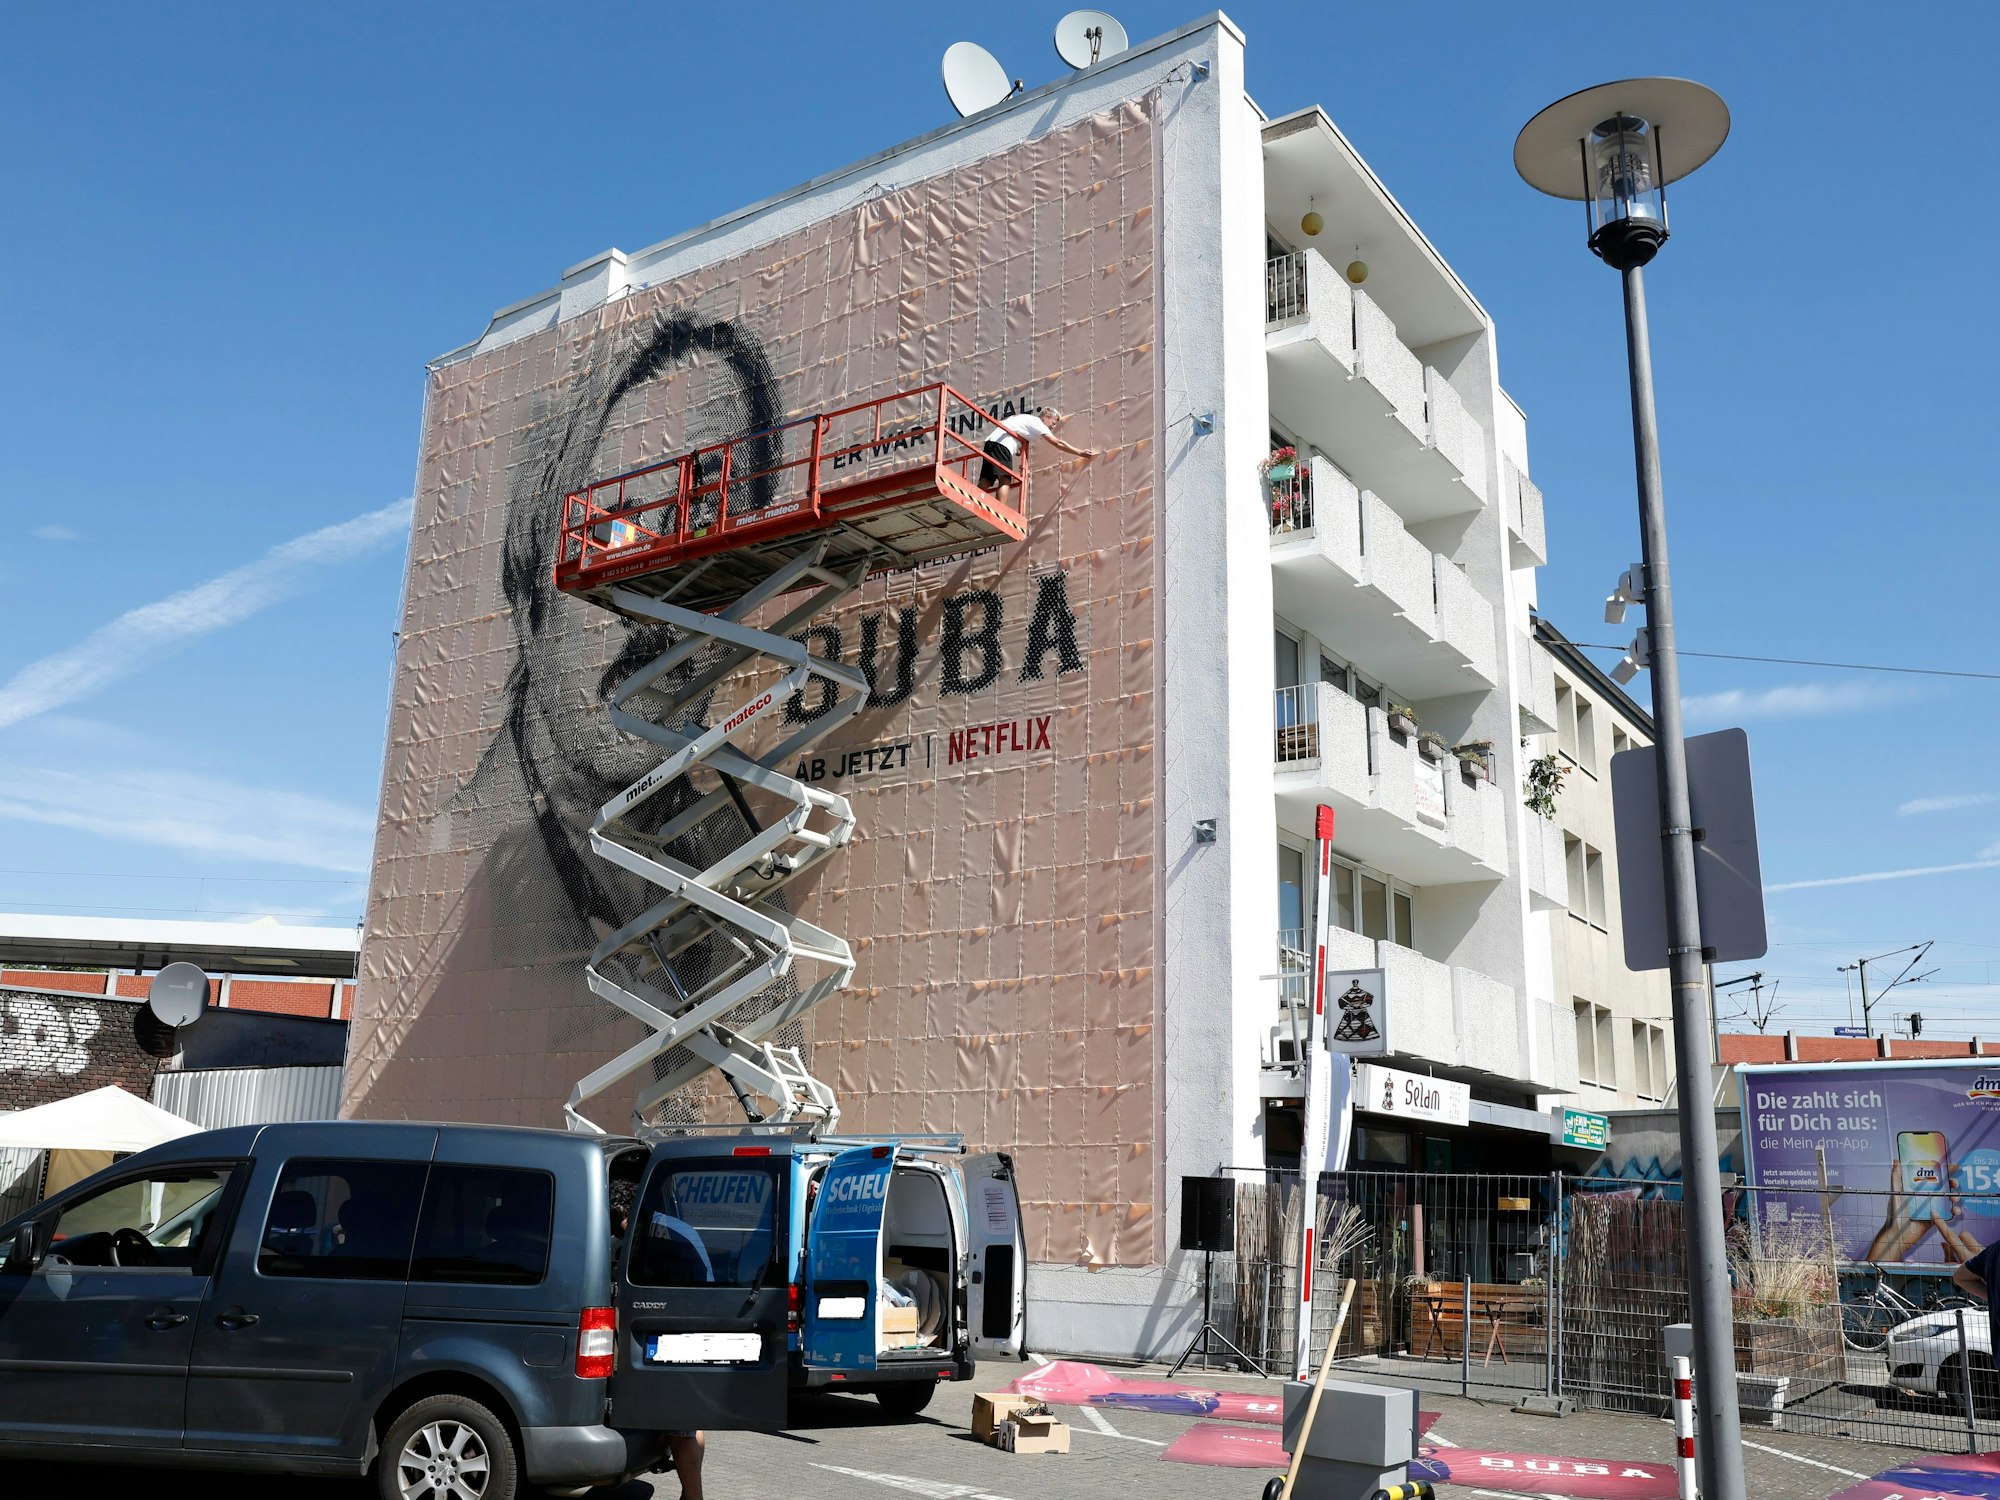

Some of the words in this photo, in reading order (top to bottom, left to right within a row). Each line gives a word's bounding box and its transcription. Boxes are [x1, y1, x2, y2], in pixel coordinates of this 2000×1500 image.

[833, 443, 862, 469] ER
[871, 426, 925, 458] WAR
[764, 502, 800, 519] mateco
[606, 543, 652, 561] www.mateco.de
[779, 569, 1086, 728] BUBA
[626, 774, 663, 803] miet...
[723, 693, 772, 734] mateco
[795, 757, 826, 783] AB
[832, 743, 913, 779] JETZT
[948, 715, 1052, 766] NETFLIX
[1974, 1076, 2000, 1090] dm
[1405, 1079, 1440, 1110] Selam
[1757, 1092, 1787, 1110] Die
[1792, 1091, 1840, 1109] zahlt
[1844, 1090, 1882, 1109] sich
[1758, 1114, 1784, 1132] für
[1790, 1114, 1832, 1131] Dich
[1837, 1116, 1877, 1131] aus:
[1760, 1136, 1779, 1149] die
[1783, 1136, 1813, 1149] Mein
[1817, 1136, 1872, 1151] dm-App.
[1973, 1156, 1986, 1165] Bis
[1763, 1169, 1778, 1177] Jetzt
[1779, 1169, 1811, 1177] anmelden
[1916, 1167, 1934, 1177] dm
[675, 1175, 767, 1204] CHEUFEN
[827, 1173, 889, 1203] SCHEU
[632, 1301, 667, 1310] CADDY
[1479, 1456, 1656, 1479] BUBA
